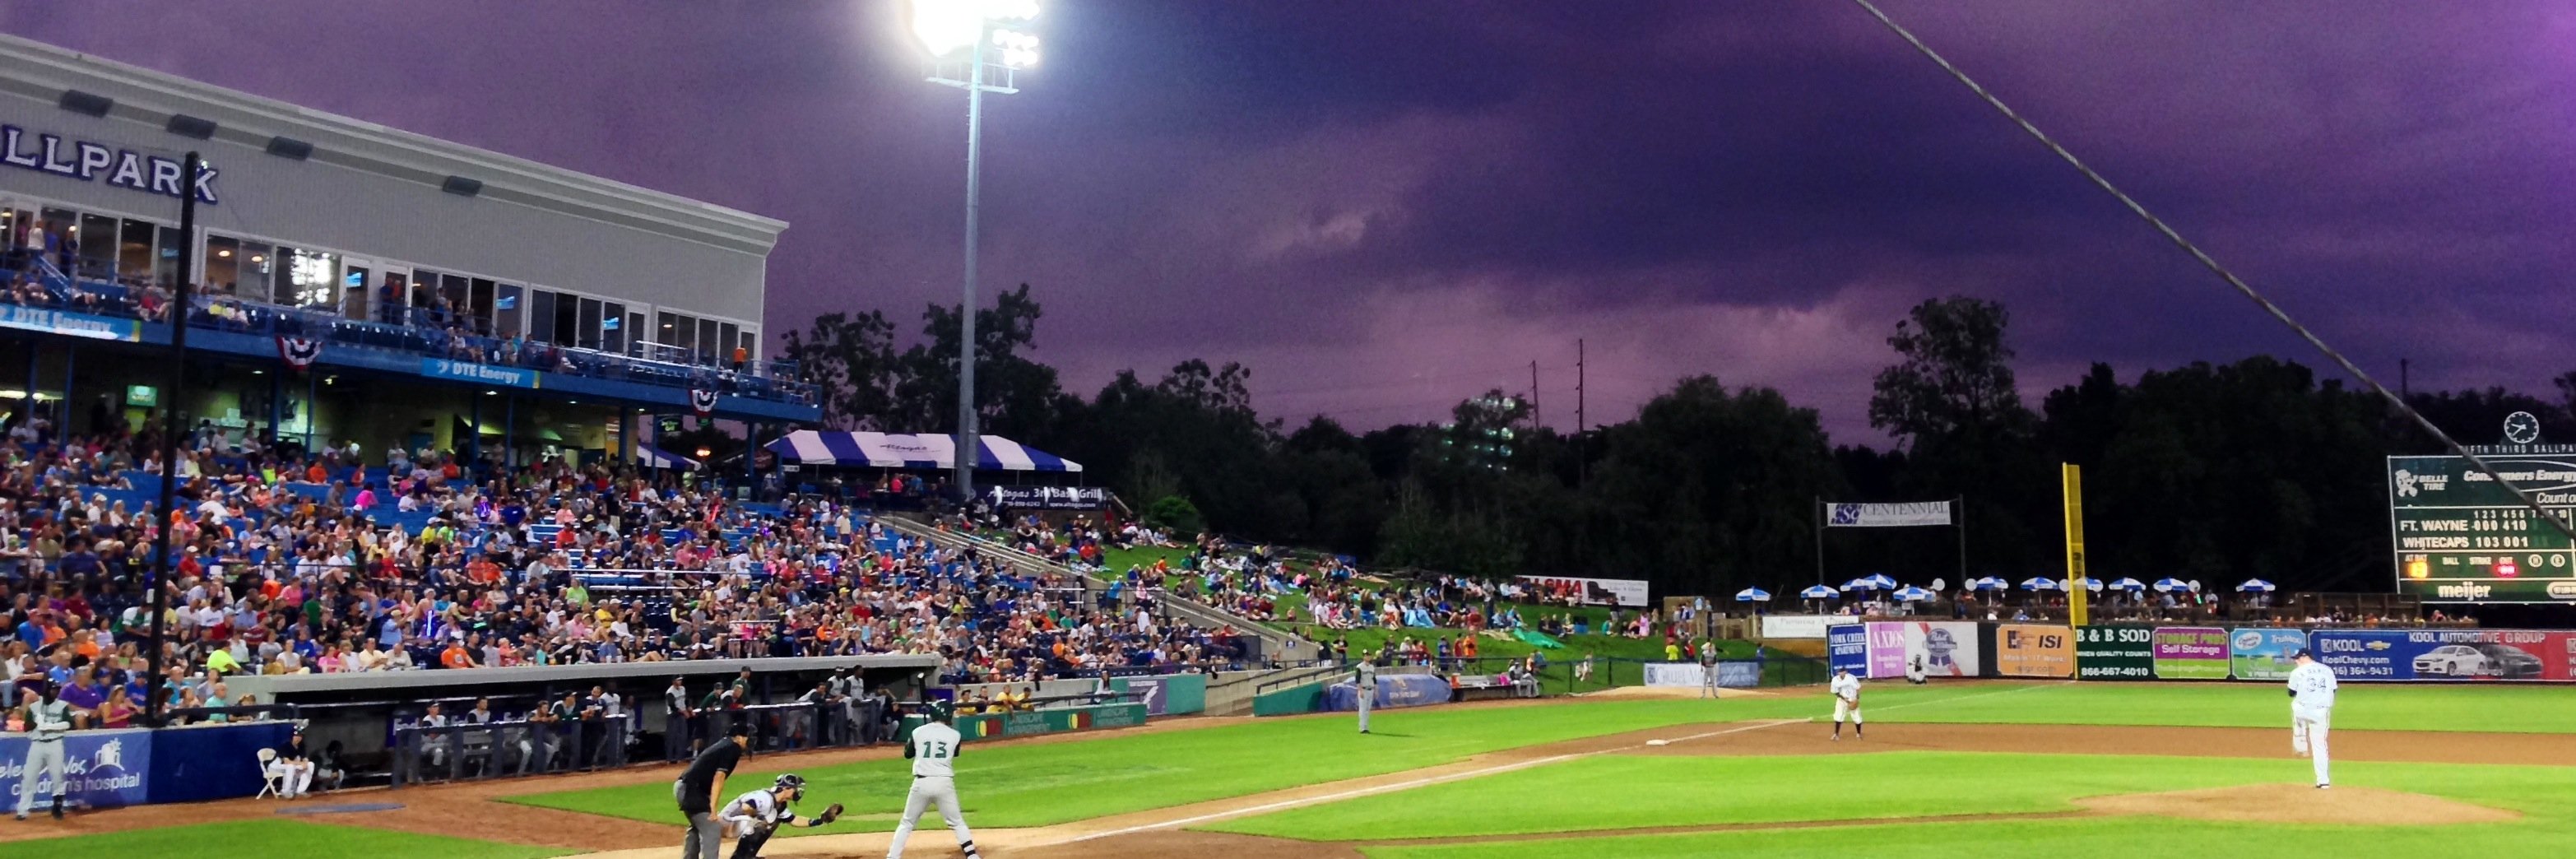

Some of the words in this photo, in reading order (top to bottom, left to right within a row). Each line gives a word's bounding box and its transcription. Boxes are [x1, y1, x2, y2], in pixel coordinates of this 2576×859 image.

[13, 307, 49, 326] DTE
[453, 362, 477, 377] DTE
[479, 365, 521, 384] Energy
[2495, 444, 2527, 453] THIRD
[2419, 475, 2448, 483] BELLE
[2537, 493, 2567, 504] Count
[1864, 502, 1947, 515] CENTENNIAL
[2473, 510, 2479, 518] 1
[2482, 510, 2488, 518] 2
[2490, 510, 2496, 518] 3
[2502, 510, 2509, 518] 4
[2511, 510, 2517, 518] 5
[2519, 510, 2525, 518] 6
[2400, 520, 2418, 532] FT.
[2421, 520, 2468, 532] WAYNE
[2402, 537, 2470, 549] WHITECAPS
[2442, 557, 2460, 565] BALL
[2469, 556, 2492, 565] STRIKE
[2499, 556, 2513, 564] OUT
[2438, 581, 2491, 601] meijer
[1830, 634, 1846, 643] YORK
[1847, 633, 1865, 643] CREEK
[1872, 630, 1905, 648] AXIOS
[2038, 634, 2062, 648] ISI
[2076, 629, 2085, 643] B
[2089, 629, 2100, 643] &
[2104, 629, 2114, 643] B
[2119, 629, 2151, 643] SOD
[2155, 633, 2198, 644] STORAGE
[2200, 633, 2227, 644] PROS
[2409, 632, 2436, 643] KOOL
[2439, 633, 2500, 643] AUTOMOTIVE
[2505, 633, 2546, 643] GROUP
[1835, 645, 1863, 655] APARTMENTS
[2161, 644, 2180, 653] Self
[2181, 644, 2220, 656] Storage
[2332, 639, 2365, 652] KOOL
[2322, 656, 2390, 665] KoolChevy.com
[2350, 666, 2393, 676] 364-9431
[2307, 678, 2327, 693] 34
[922, 741, 948, 759] 13
[84, 772, 140, 792] hospital
